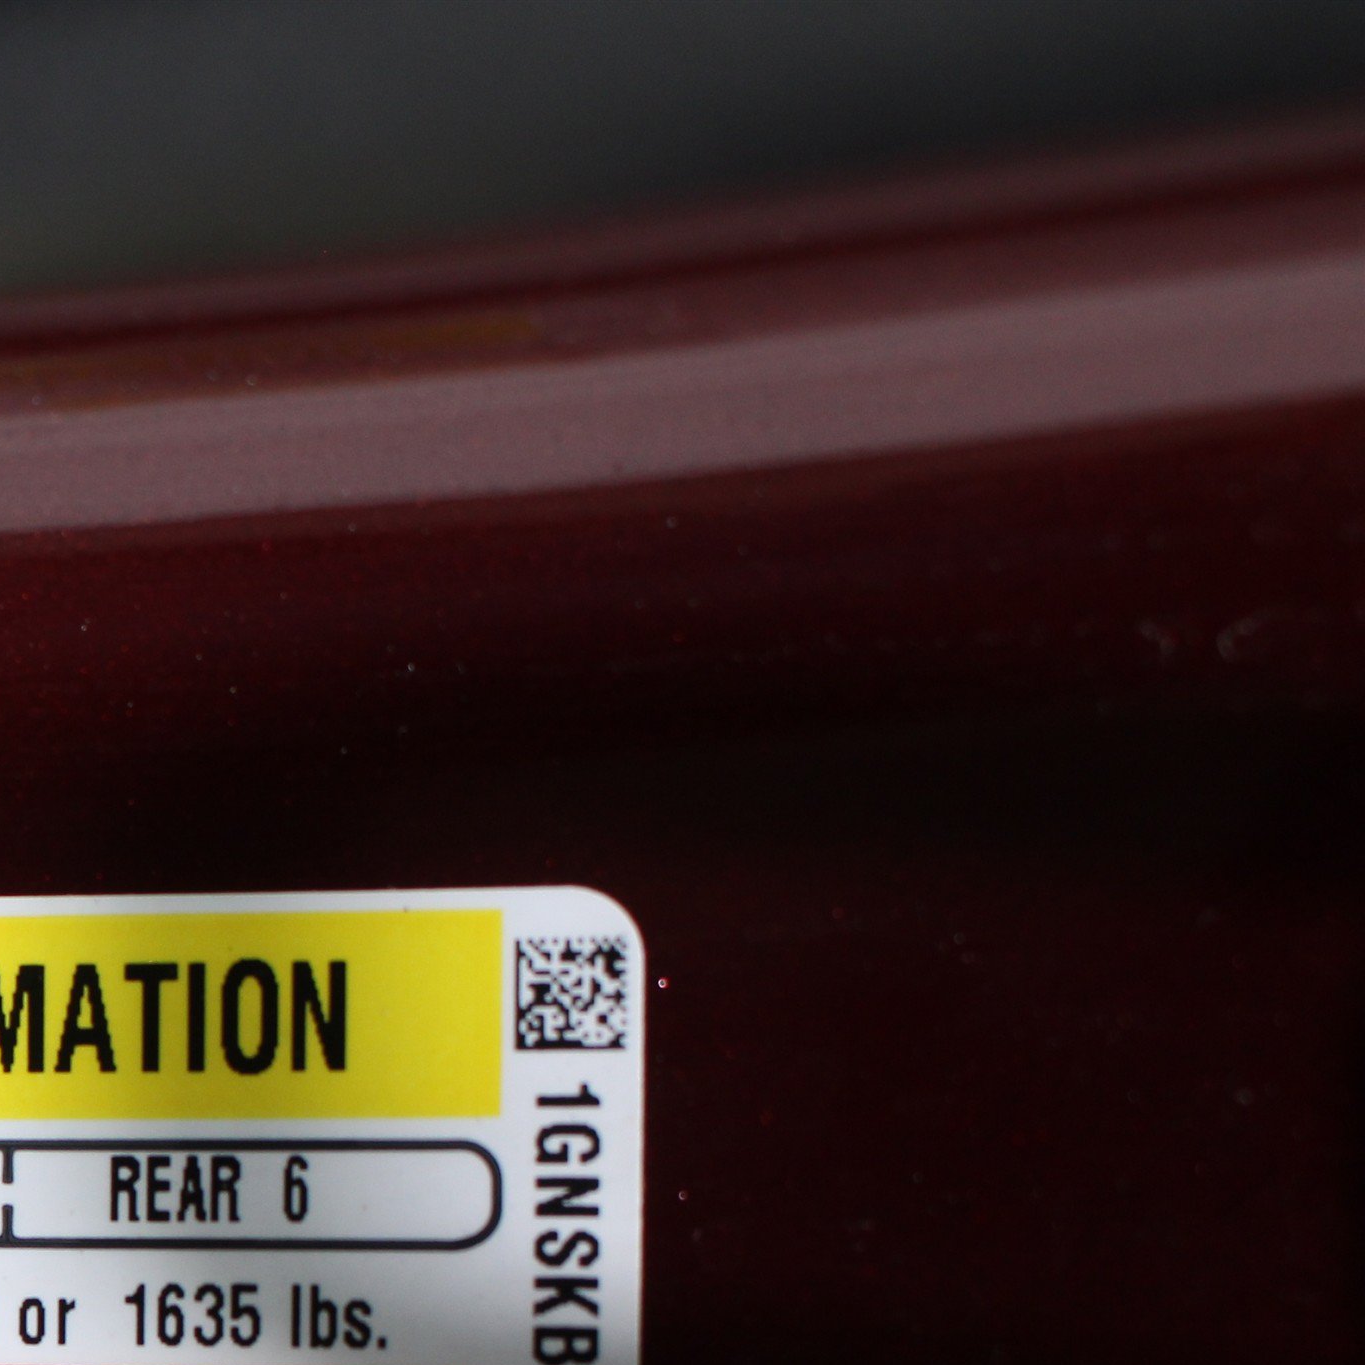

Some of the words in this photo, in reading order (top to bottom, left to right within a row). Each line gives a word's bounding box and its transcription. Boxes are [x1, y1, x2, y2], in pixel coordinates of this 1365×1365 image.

[110, 1153, 241, 1222] REAR
[283, 1153, 311, 1222] 6
[20, 1299, 74, 1344] or
[125, 1282, 261, 1347] 1635
[290, 1283, 388, 1351] lbs.
